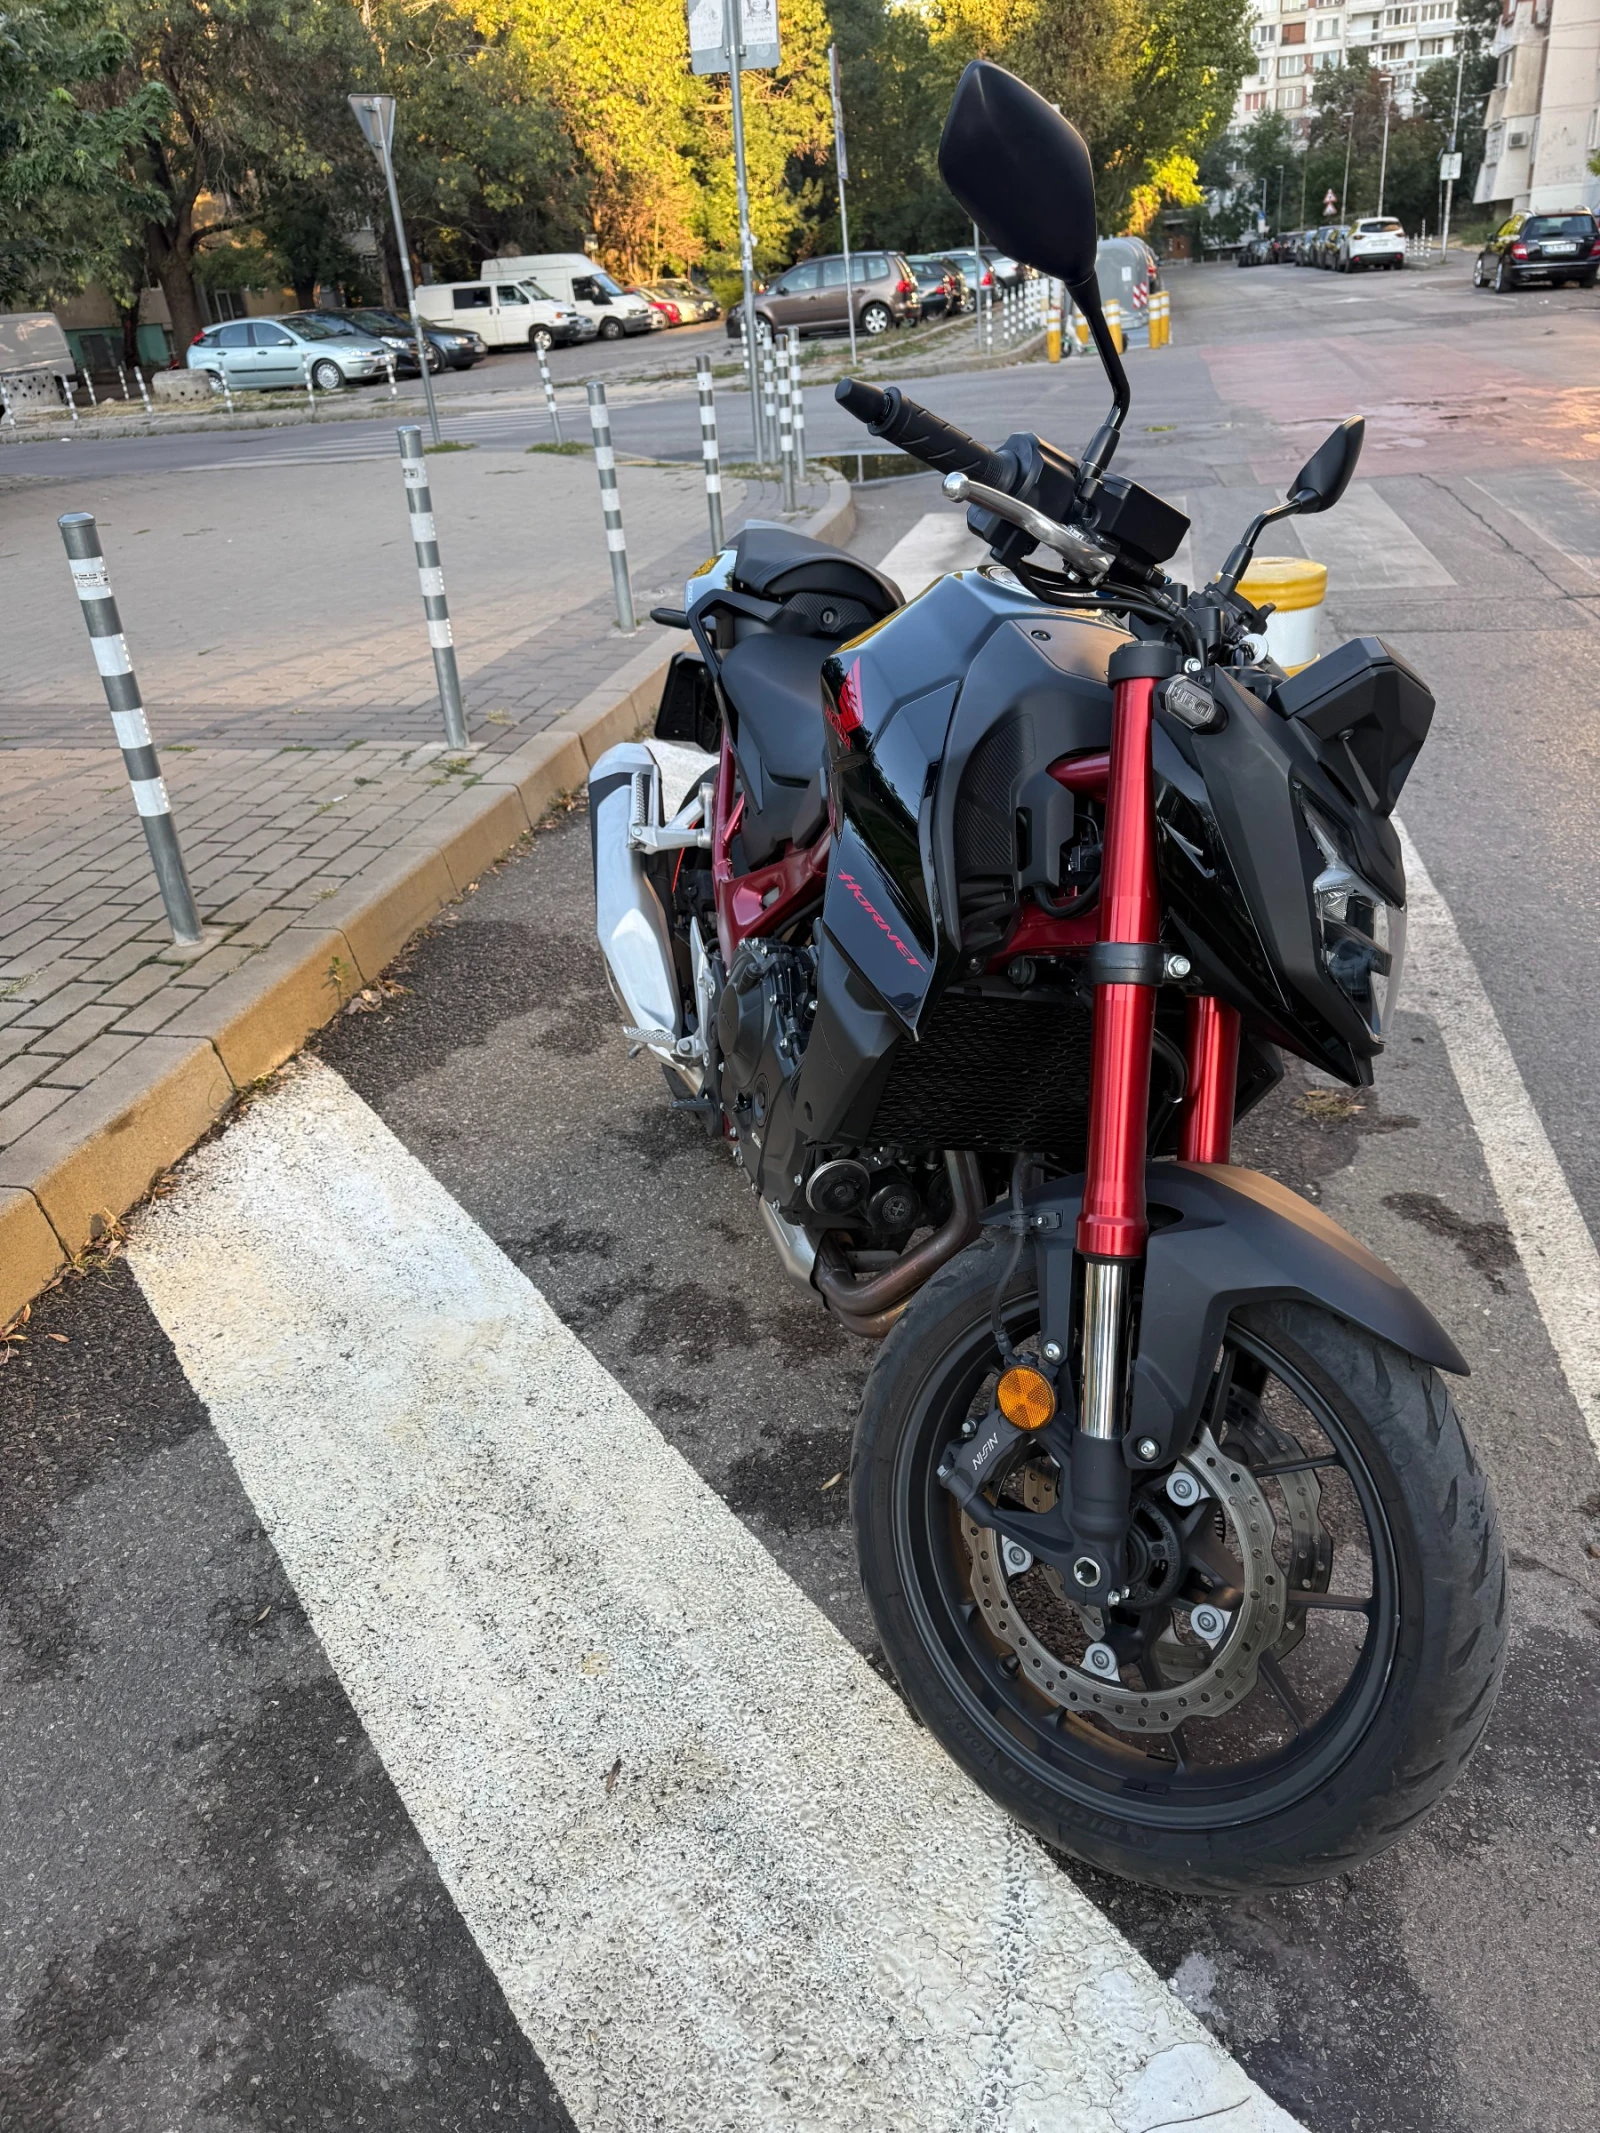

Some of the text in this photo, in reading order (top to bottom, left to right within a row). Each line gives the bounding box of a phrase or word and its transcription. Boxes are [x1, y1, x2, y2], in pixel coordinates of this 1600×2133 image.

[838, 868, 926, 973] HORNET
[972, 1432, 999, 1471] NISSIN
[954, 1721, 989, 1759] ROAD
[1003, 1767, 1121, 1837] MICHELIN
